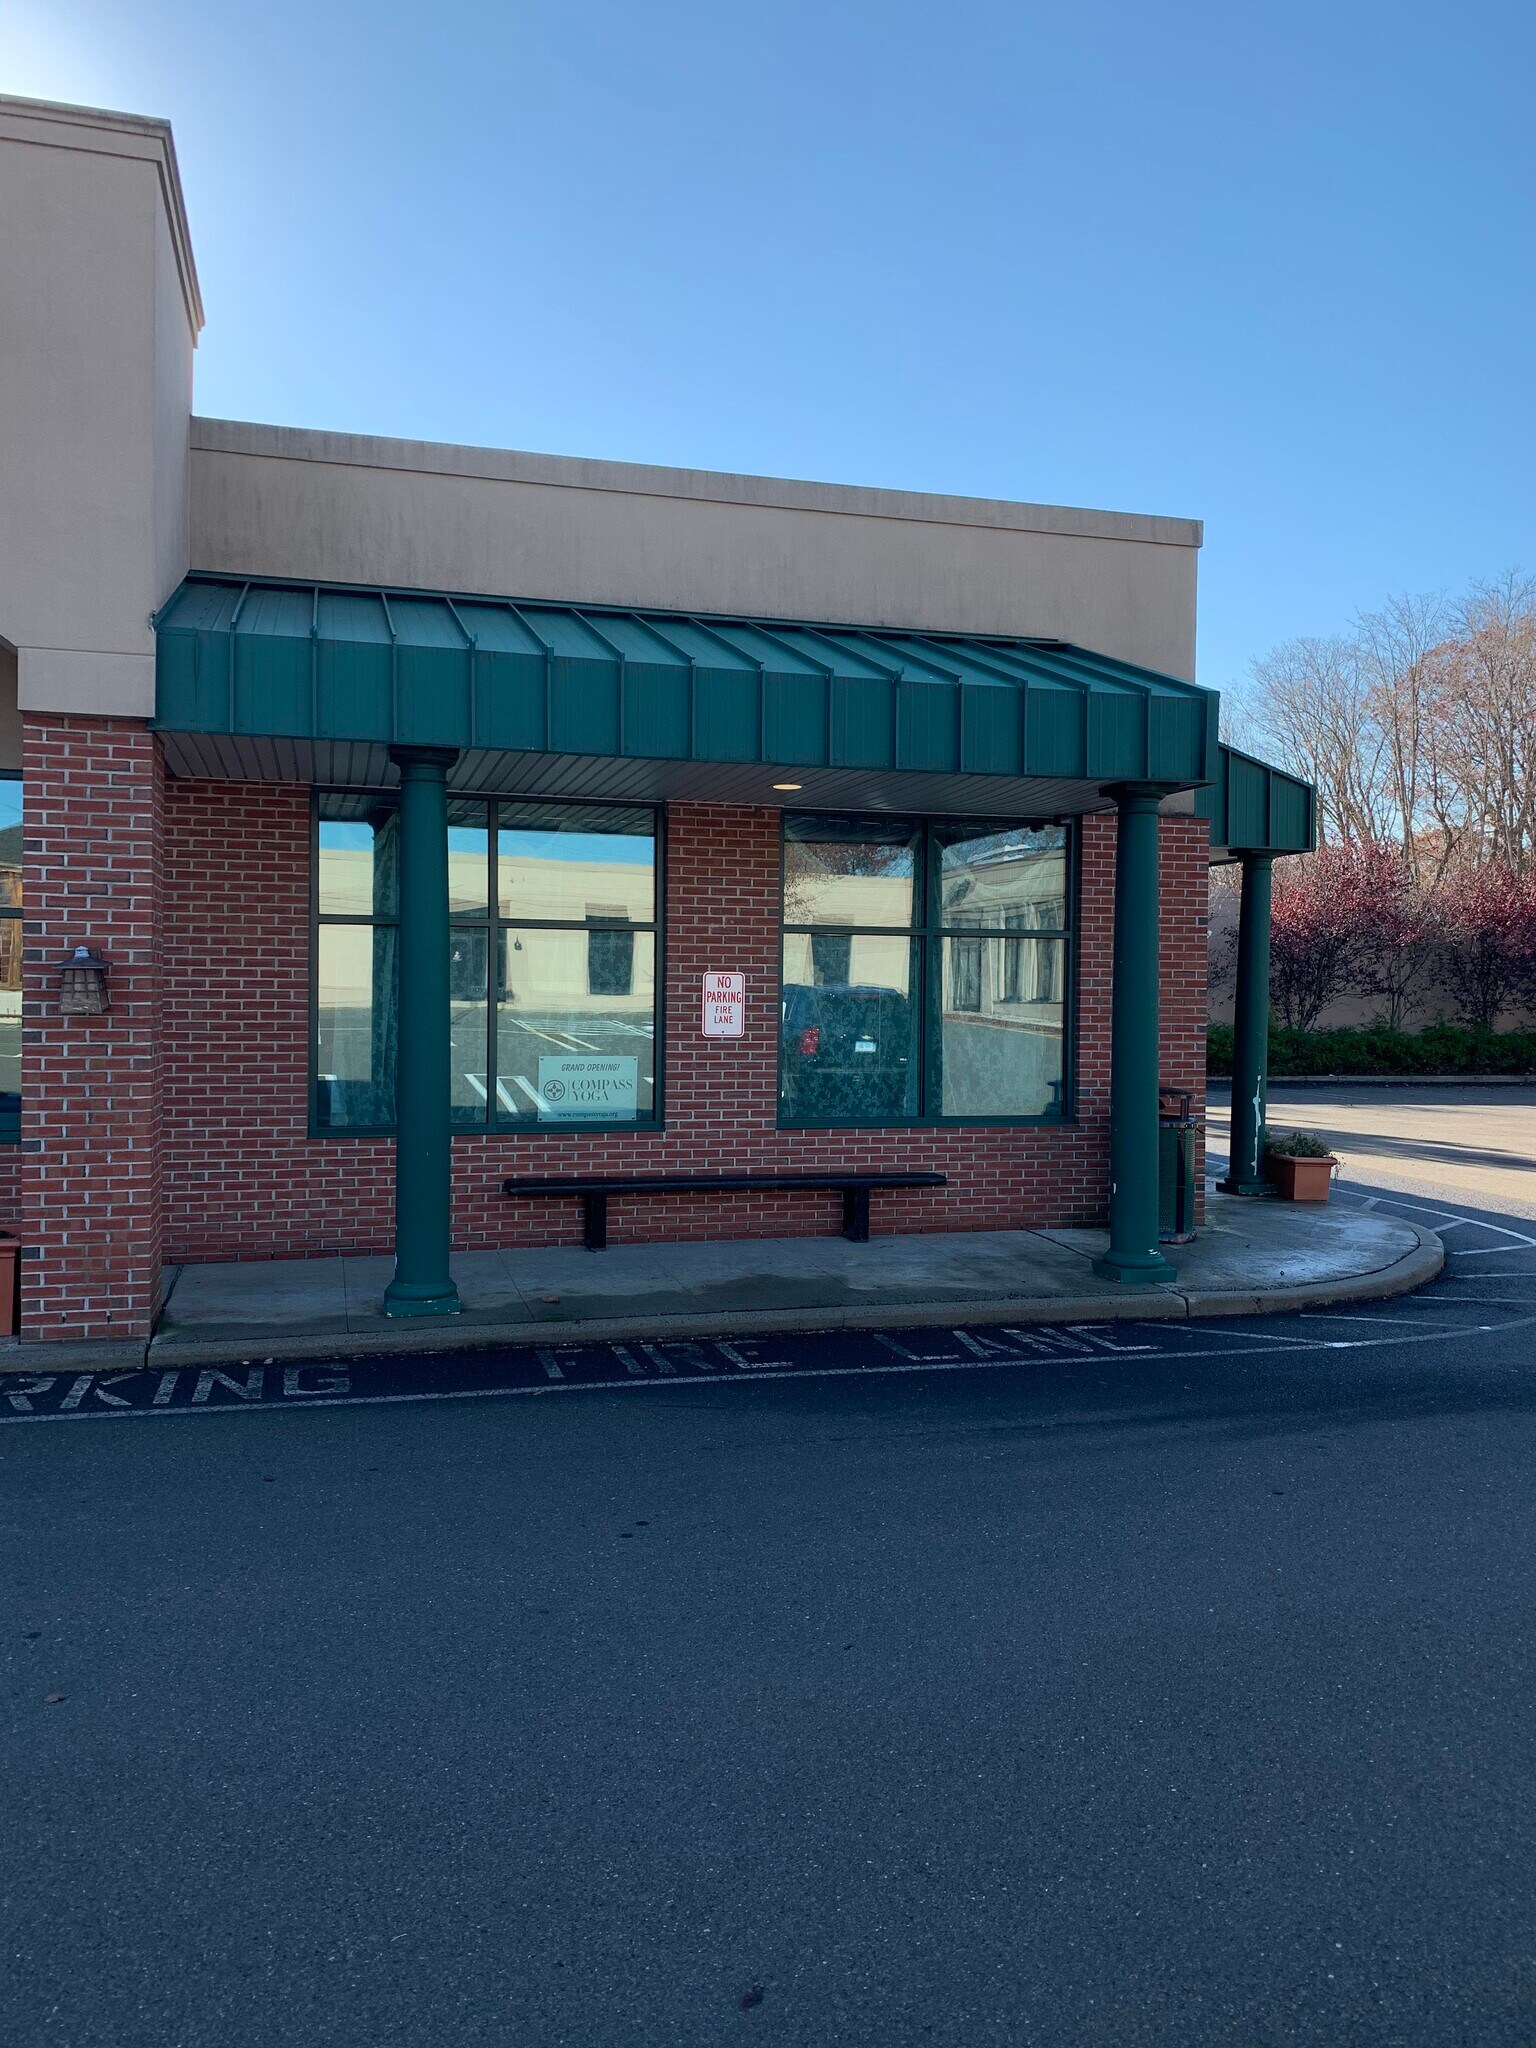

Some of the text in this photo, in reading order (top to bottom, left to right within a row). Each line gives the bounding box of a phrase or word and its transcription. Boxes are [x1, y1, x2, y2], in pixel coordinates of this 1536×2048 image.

[717, 976, 732, 989] NO
[706, 991, 742, 1003] PARKING
[715, 1005, 733, 1014] FIRE
[714, 1015, 734, 1024] LANE
[561, 1063, 621, 1072] GRAND OPENING!
[571, 1079, 633, 1091] COMPASS
[572, 1090, 609, 1101] YOGA
[873, 1325, 1164, 1361] LANE
